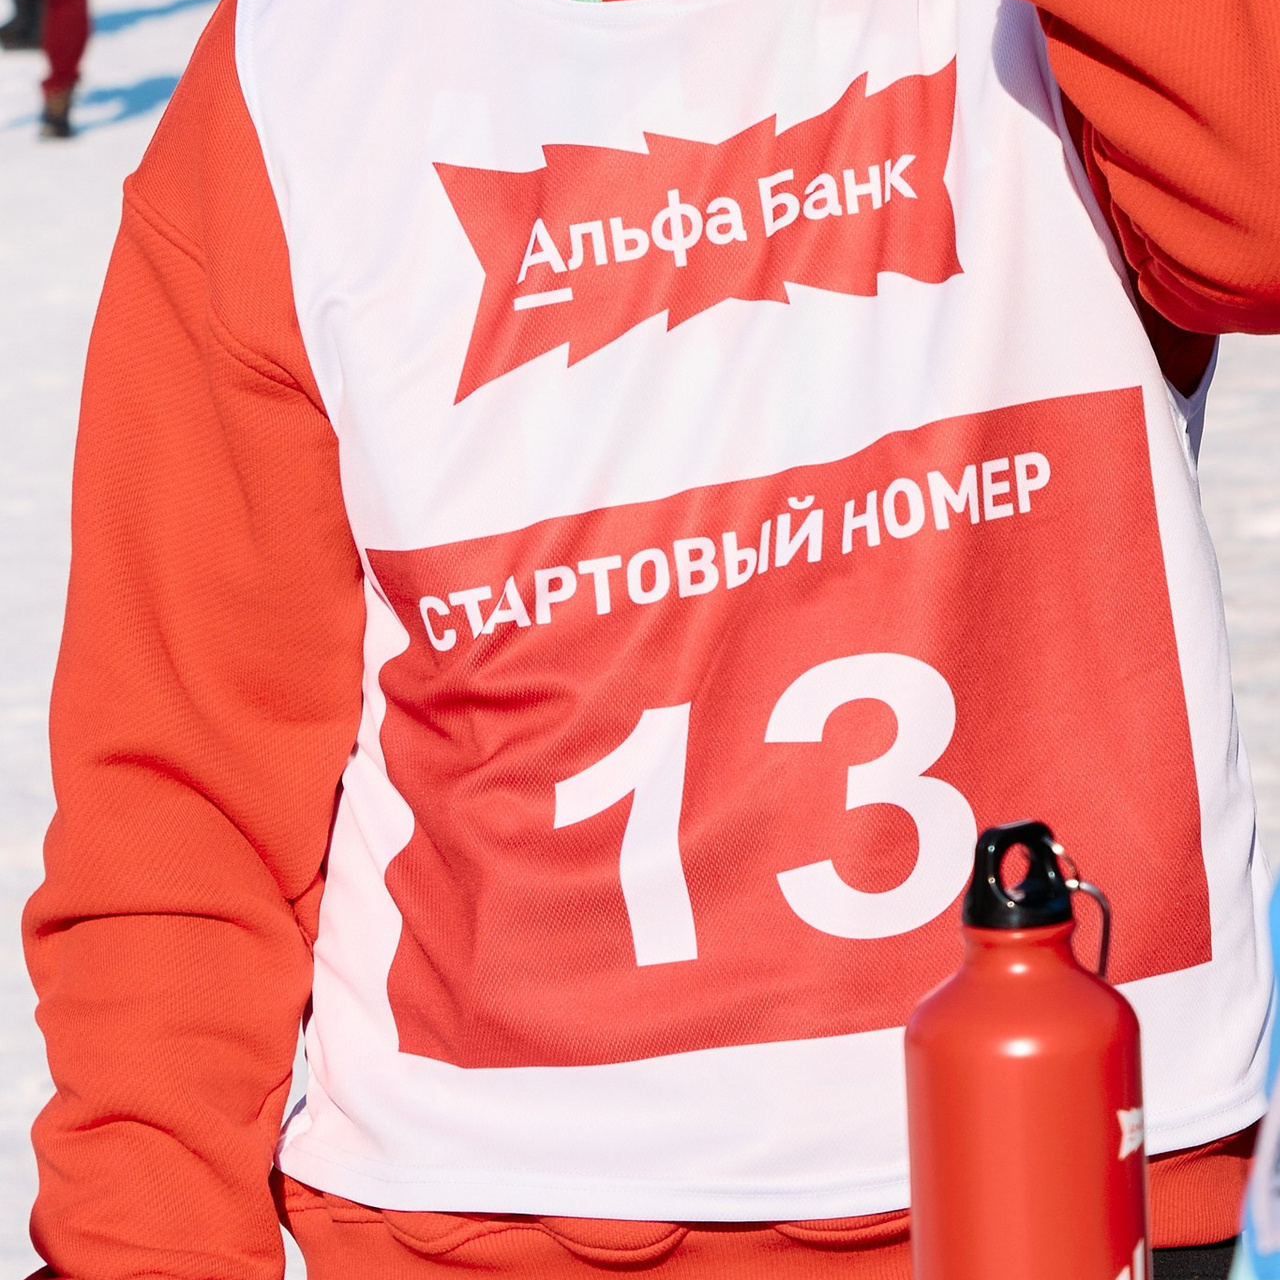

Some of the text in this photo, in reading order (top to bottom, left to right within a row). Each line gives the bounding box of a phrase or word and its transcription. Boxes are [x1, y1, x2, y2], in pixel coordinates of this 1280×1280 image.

[516, 153, 918, 288] Альфа Банк
[418, 450, 1052, 652] СТАРТОВЫЙ НОМЕР
[552, 651, 979, 968] 13
